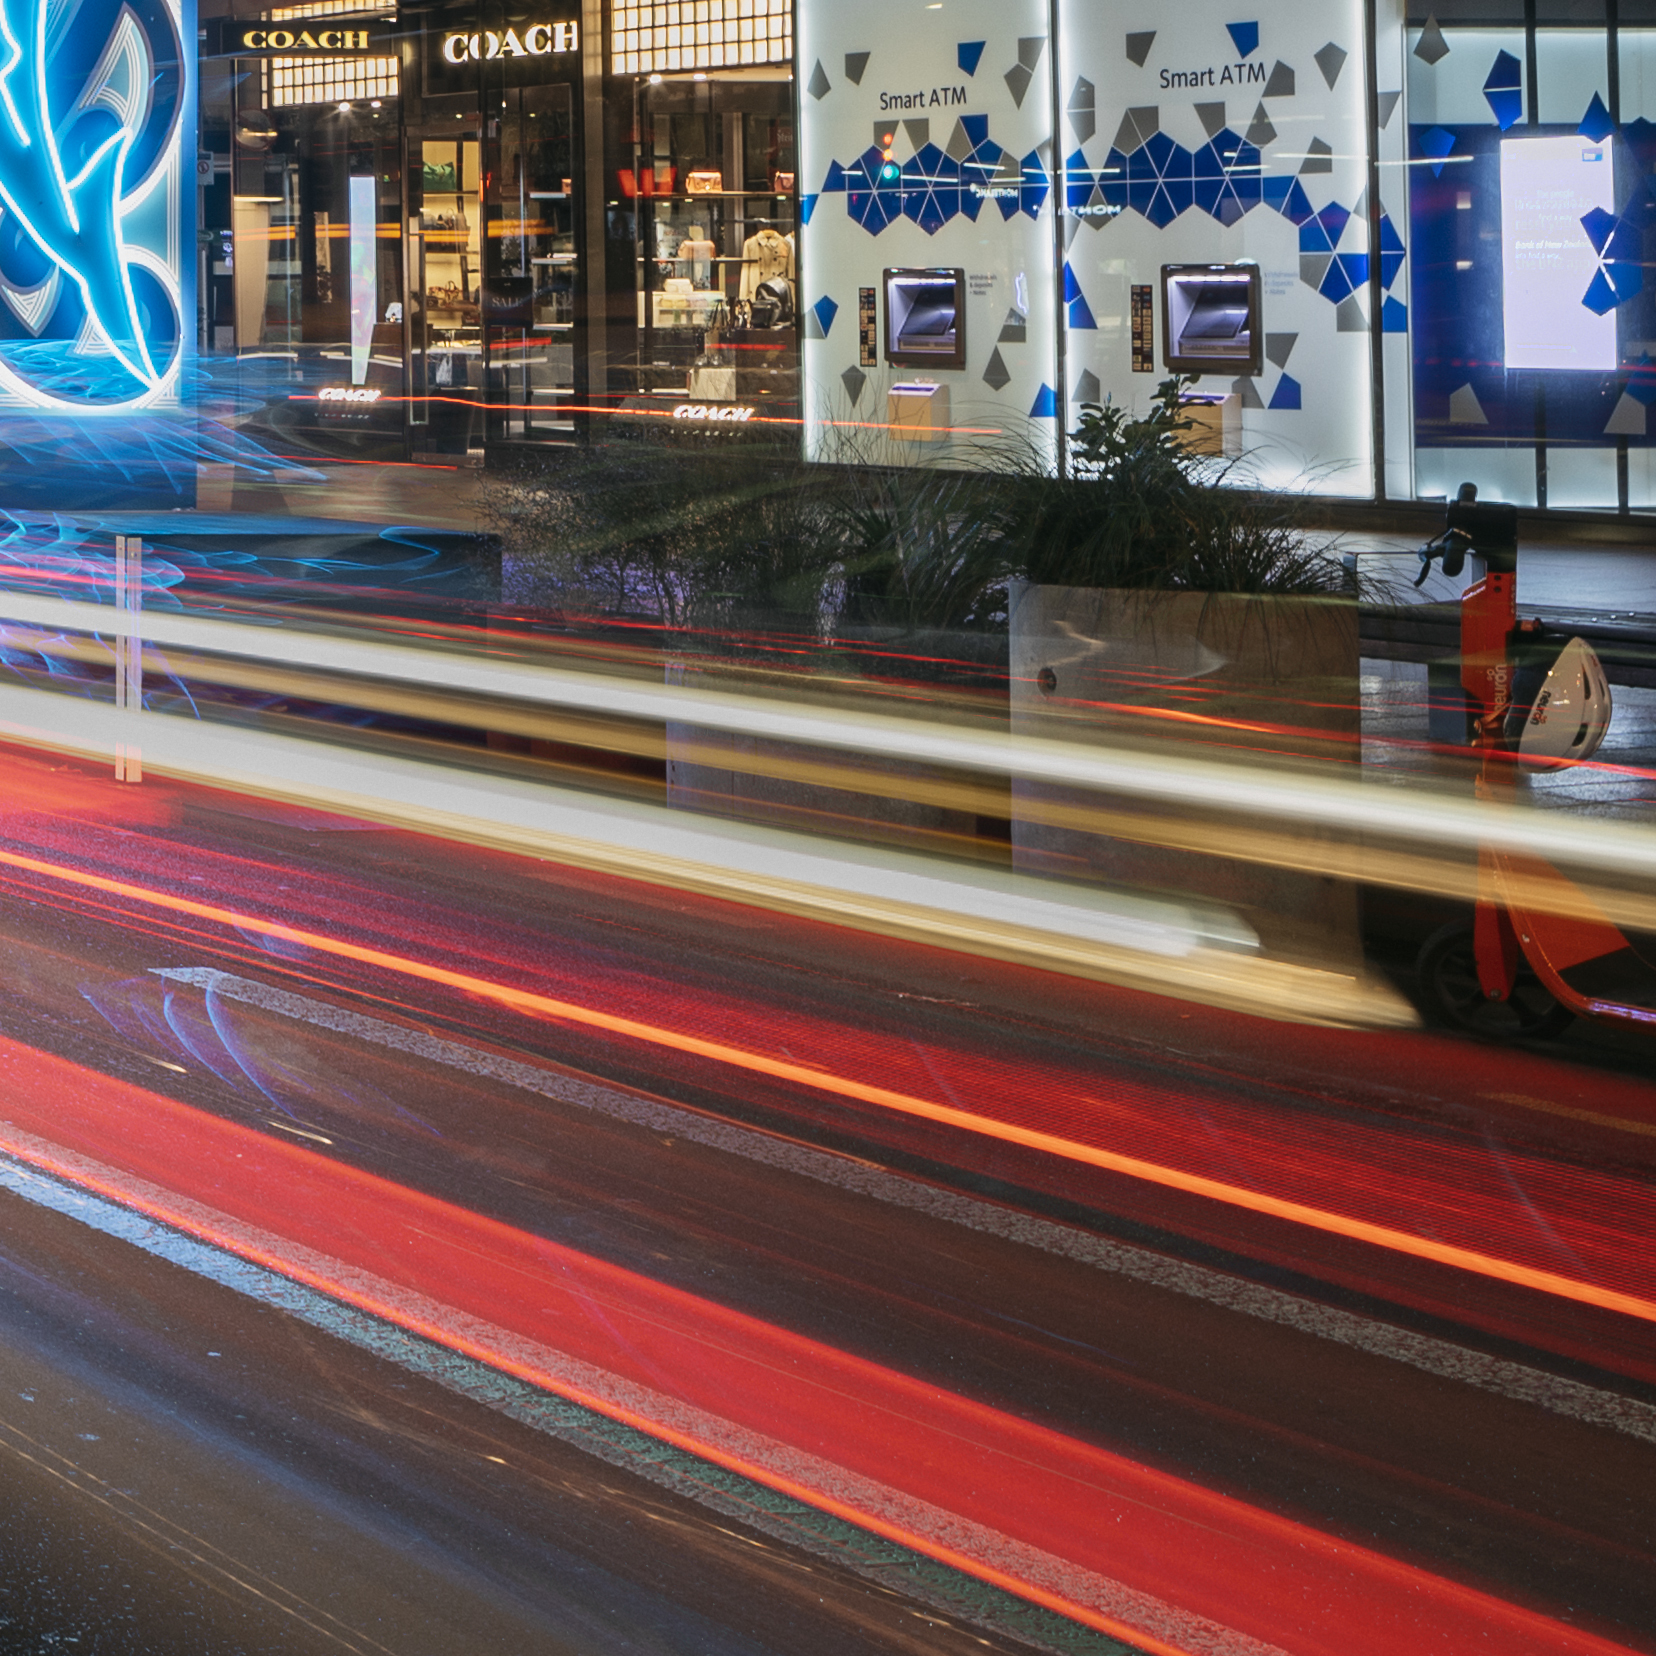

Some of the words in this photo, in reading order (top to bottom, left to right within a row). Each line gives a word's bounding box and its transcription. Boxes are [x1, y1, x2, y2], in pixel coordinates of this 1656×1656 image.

[243, 30, 369, 50] COACH
[443, 20, 579, 64] COACH
[1159, 66, 1215, 89] Smart
[1219, 62, 1266, 86] ATM
[879, 90, 925, 111] Smart
[929, 86, 967, 108] ATM
[491, 297, 524, 308] SALE
[672, 404, 755, 421] COACH
